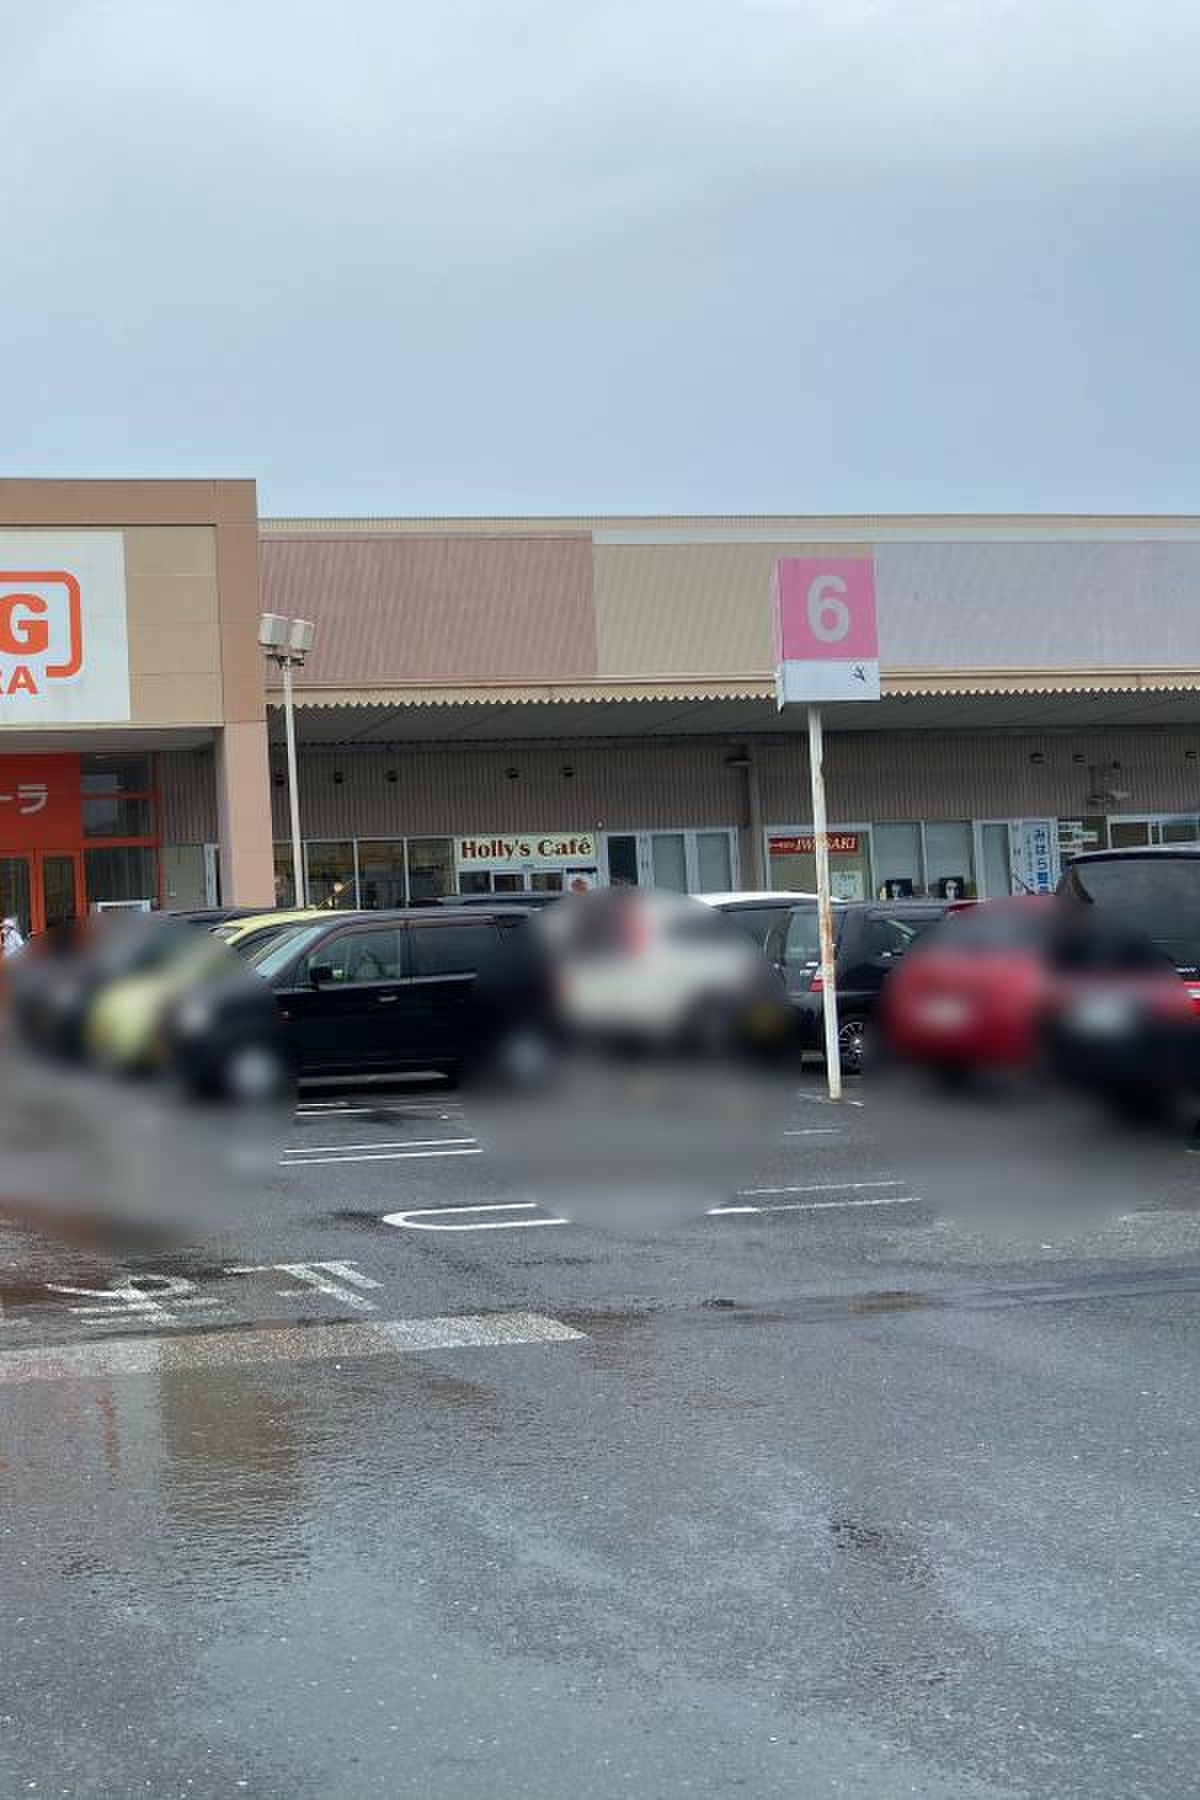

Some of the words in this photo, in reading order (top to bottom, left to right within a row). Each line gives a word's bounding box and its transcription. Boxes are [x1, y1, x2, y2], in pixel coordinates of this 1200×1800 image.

[807, 575, 849, 641] 6
[462, 838, 531, 861] Holly's
[537, 837, 592, 857] Café
[795, 838, 856, 851] IWAKI
